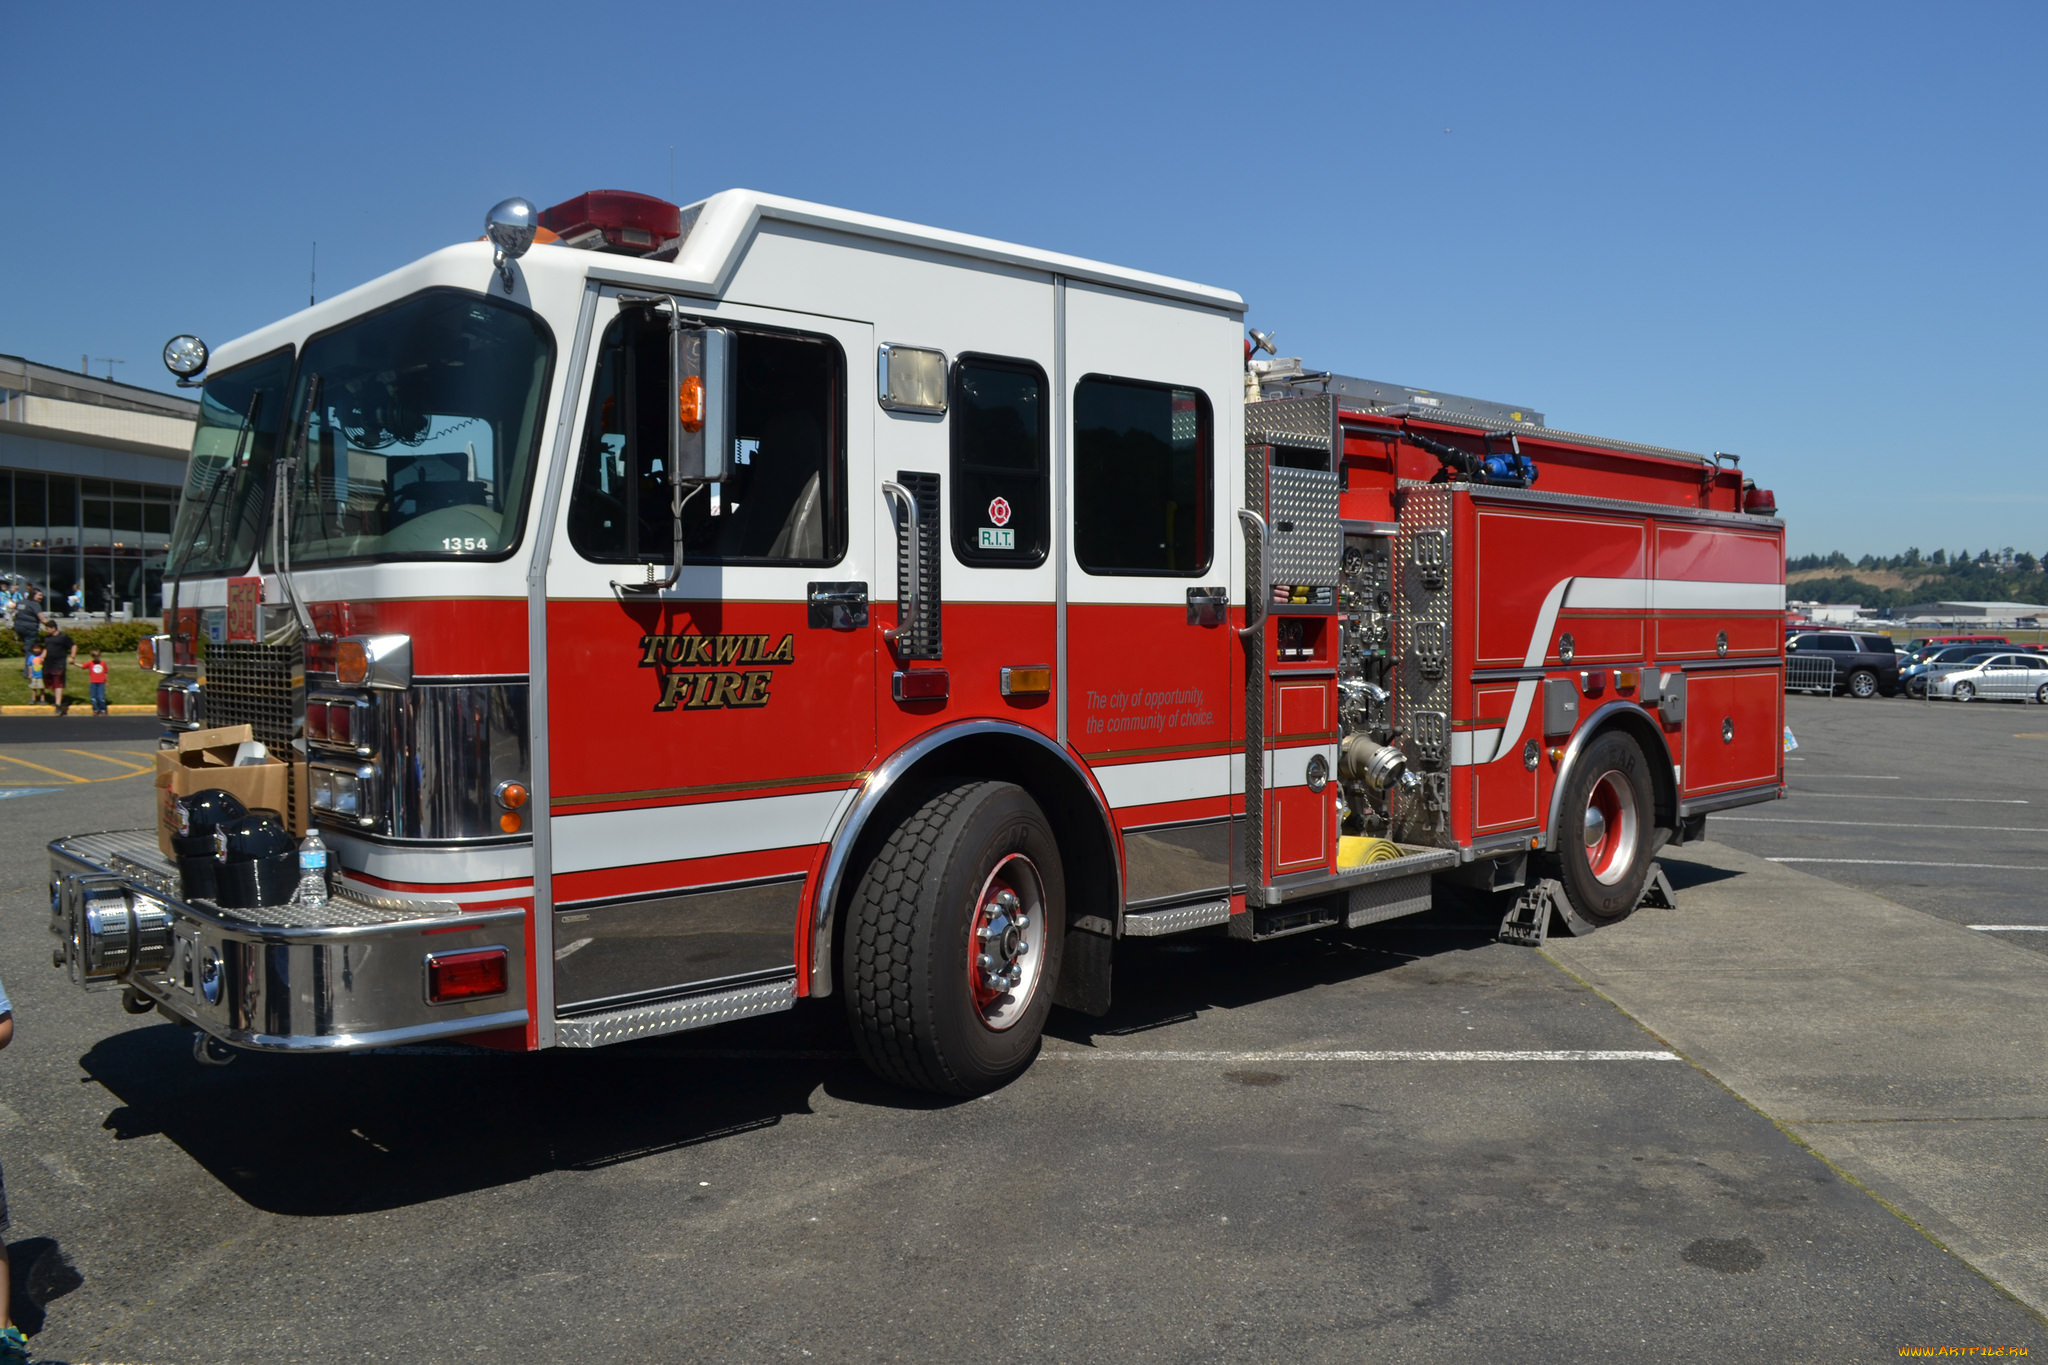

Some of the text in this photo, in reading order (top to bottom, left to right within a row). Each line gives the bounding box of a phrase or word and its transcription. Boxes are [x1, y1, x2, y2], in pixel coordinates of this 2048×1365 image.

[442, 537, 488, 551] 1354
[981, 530, 1012, 546] R.I.T.
[229, 582, 258, 634] 511
[638, 633, 795, 668] TUKWILA
[653, 670, 774, 712] FIRE
[1086, 690, 1107, 709] The
[1110, 689, 1129, 712] city
[1131, 688, 1144, 707] of
[1086, 708, 1215, 734] the community of choice.
